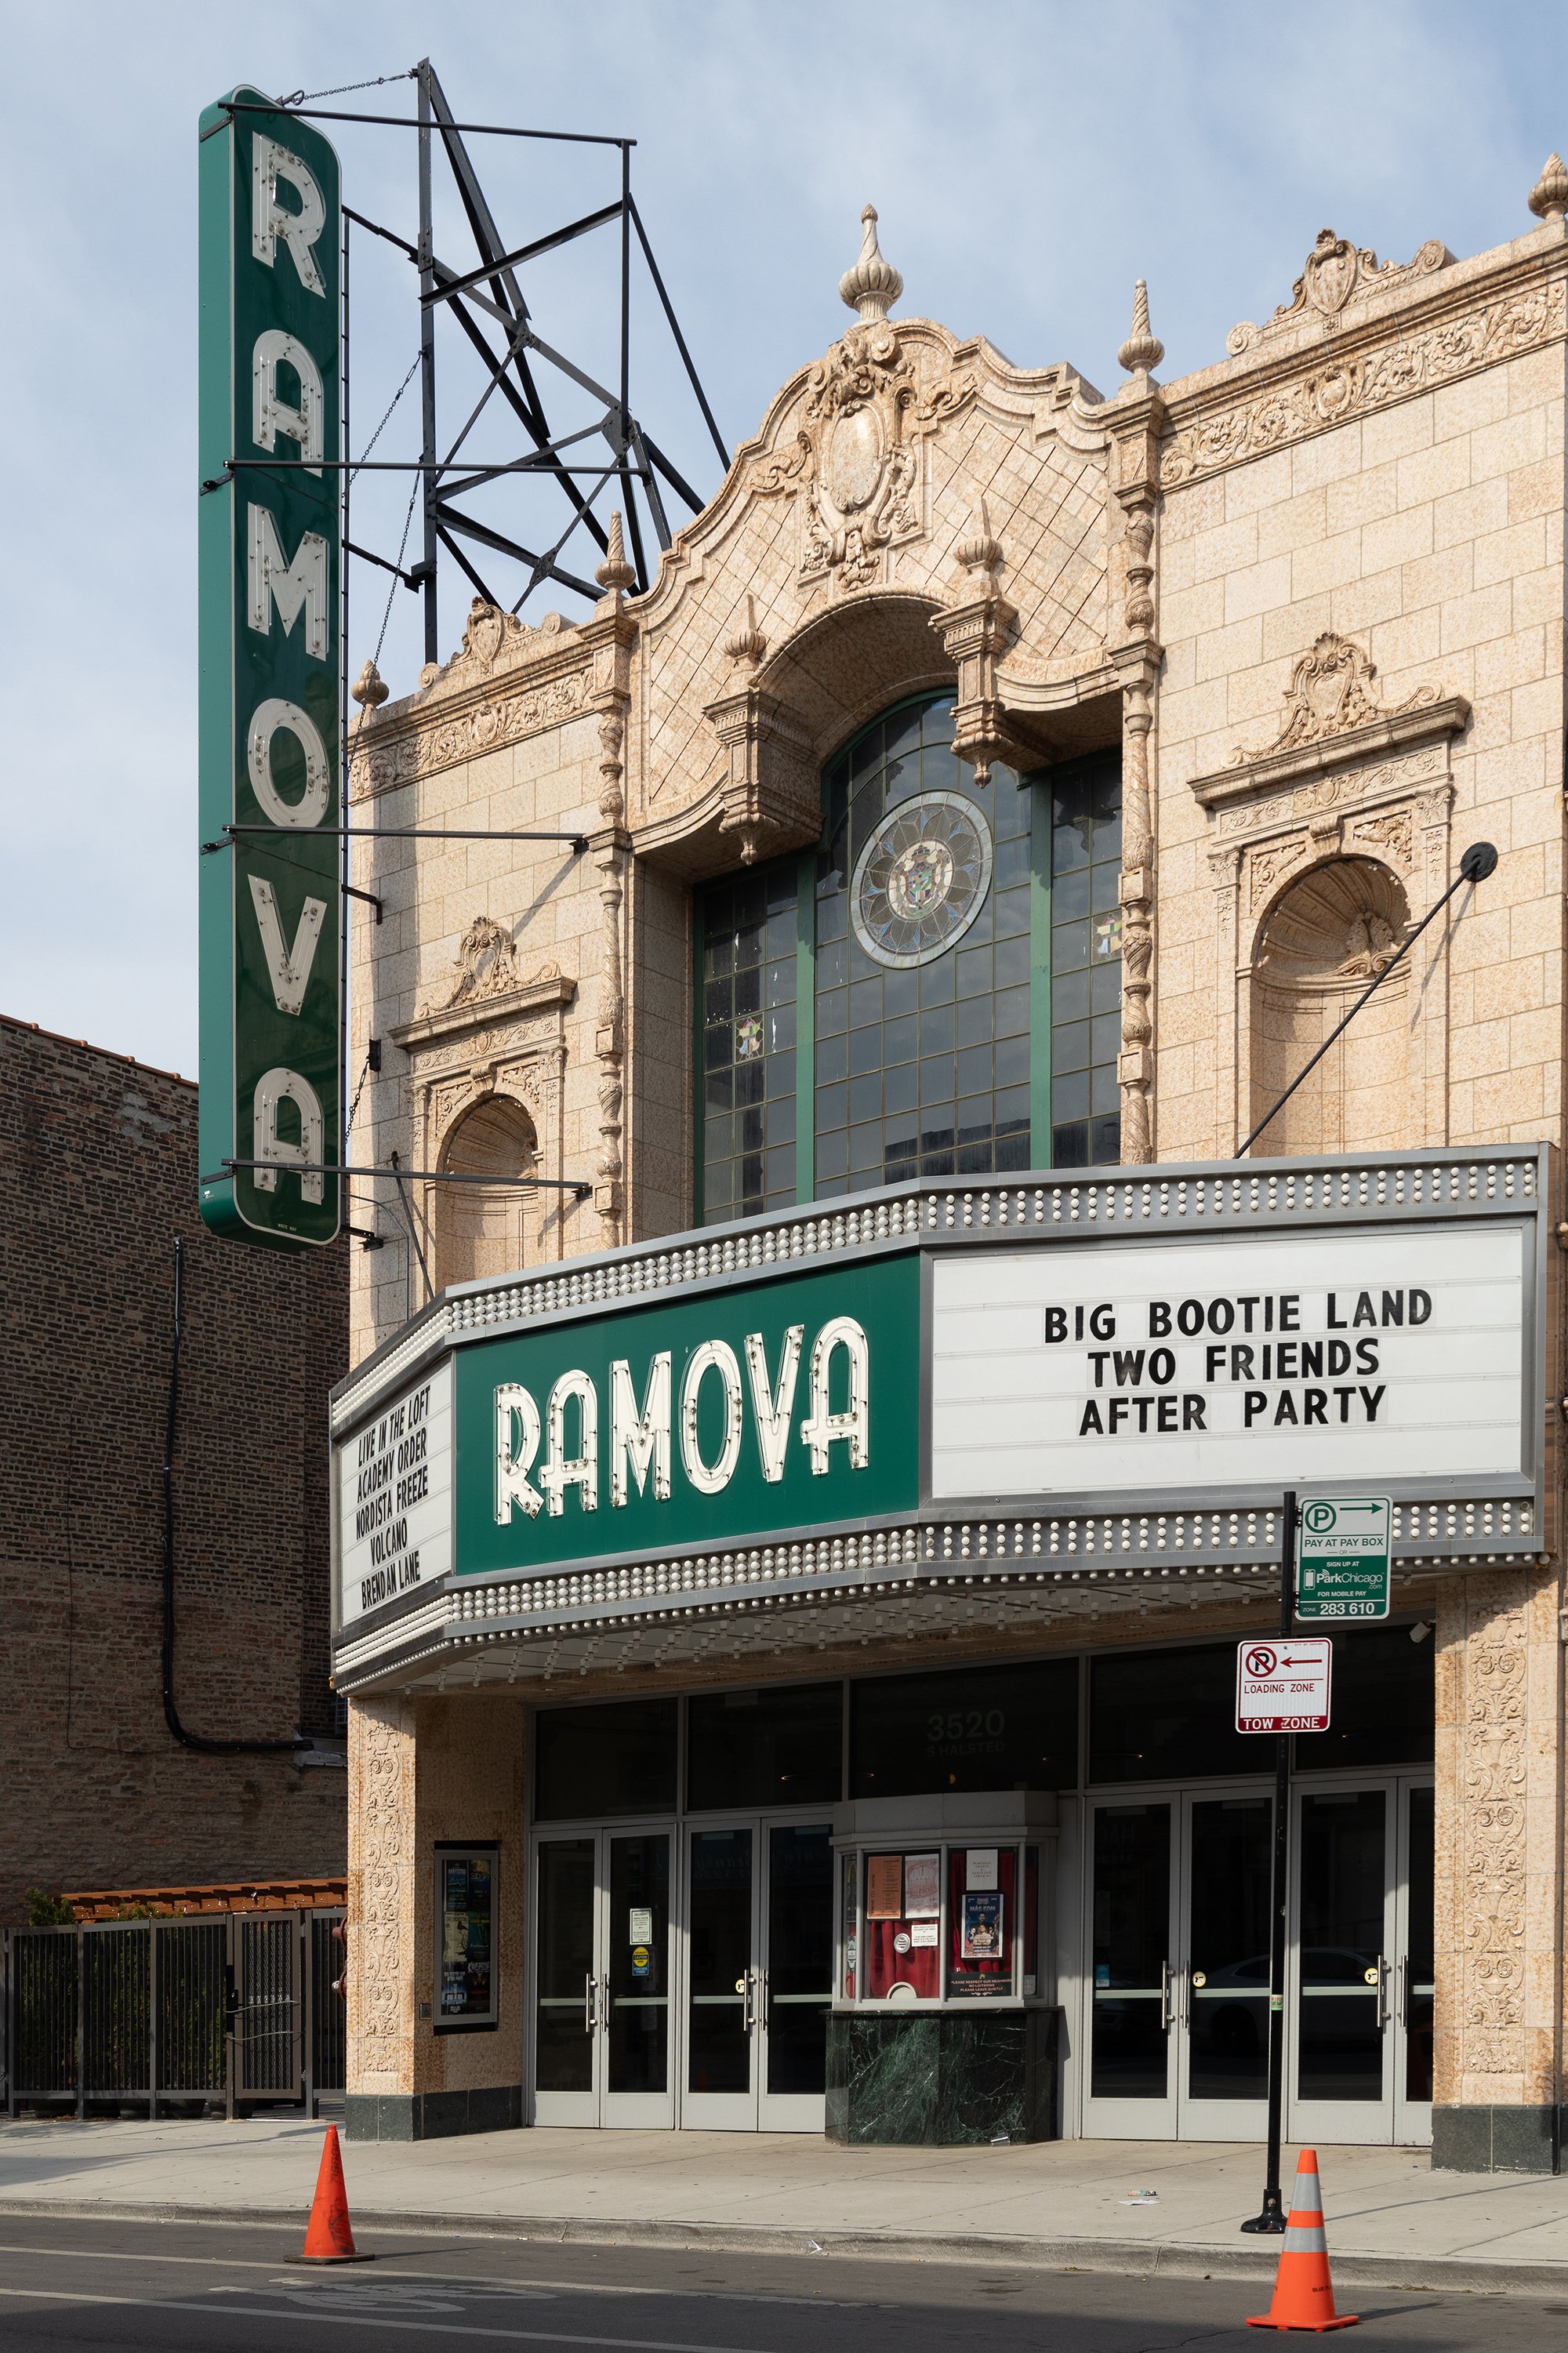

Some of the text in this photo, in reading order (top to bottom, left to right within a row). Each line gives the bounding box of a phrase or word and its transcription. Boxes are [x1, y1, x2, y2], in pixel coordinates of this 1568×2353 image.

[248, 130, 329, 1206] RAMOVA
[1044, 1288, 1432, 1343] BIG BOOTIE LAND
[1087, 1338, 1379, 1388] TWO FRIENDS
[358, 1385, 431, 1468] LIVE IN THE LOFT
[493, 1316, 869, 1525] RAMOVA
[1079, 1385, 1386, 1436] AFTER PARTY
[357, 1427, 427, 1504] ACADEMY ORDER
[356, 1464, 429, 1541] NORDISTA FREEZE
[370, 1517, 408, 1567] VOLCANO
[1325, 1538, 1338, 1547] AT
[1362, 1538, 1384, 1546] BOX
[399, 1550, 421, 1590] LANE
[1316, 1572, 1383, 1585] ParkChicago
[1319, 1603, 1345, 1615] 283
[1348, 1602, 1375, 1614] 610
[1244, 1683, 1315, 1694] LOADING ZONE
[927, 1709, 1004, 1741] 3520
[1243, 1717, 1319, 1730] TOW ZONE
[926, 1740, 1004, 1758] S HALSTED
